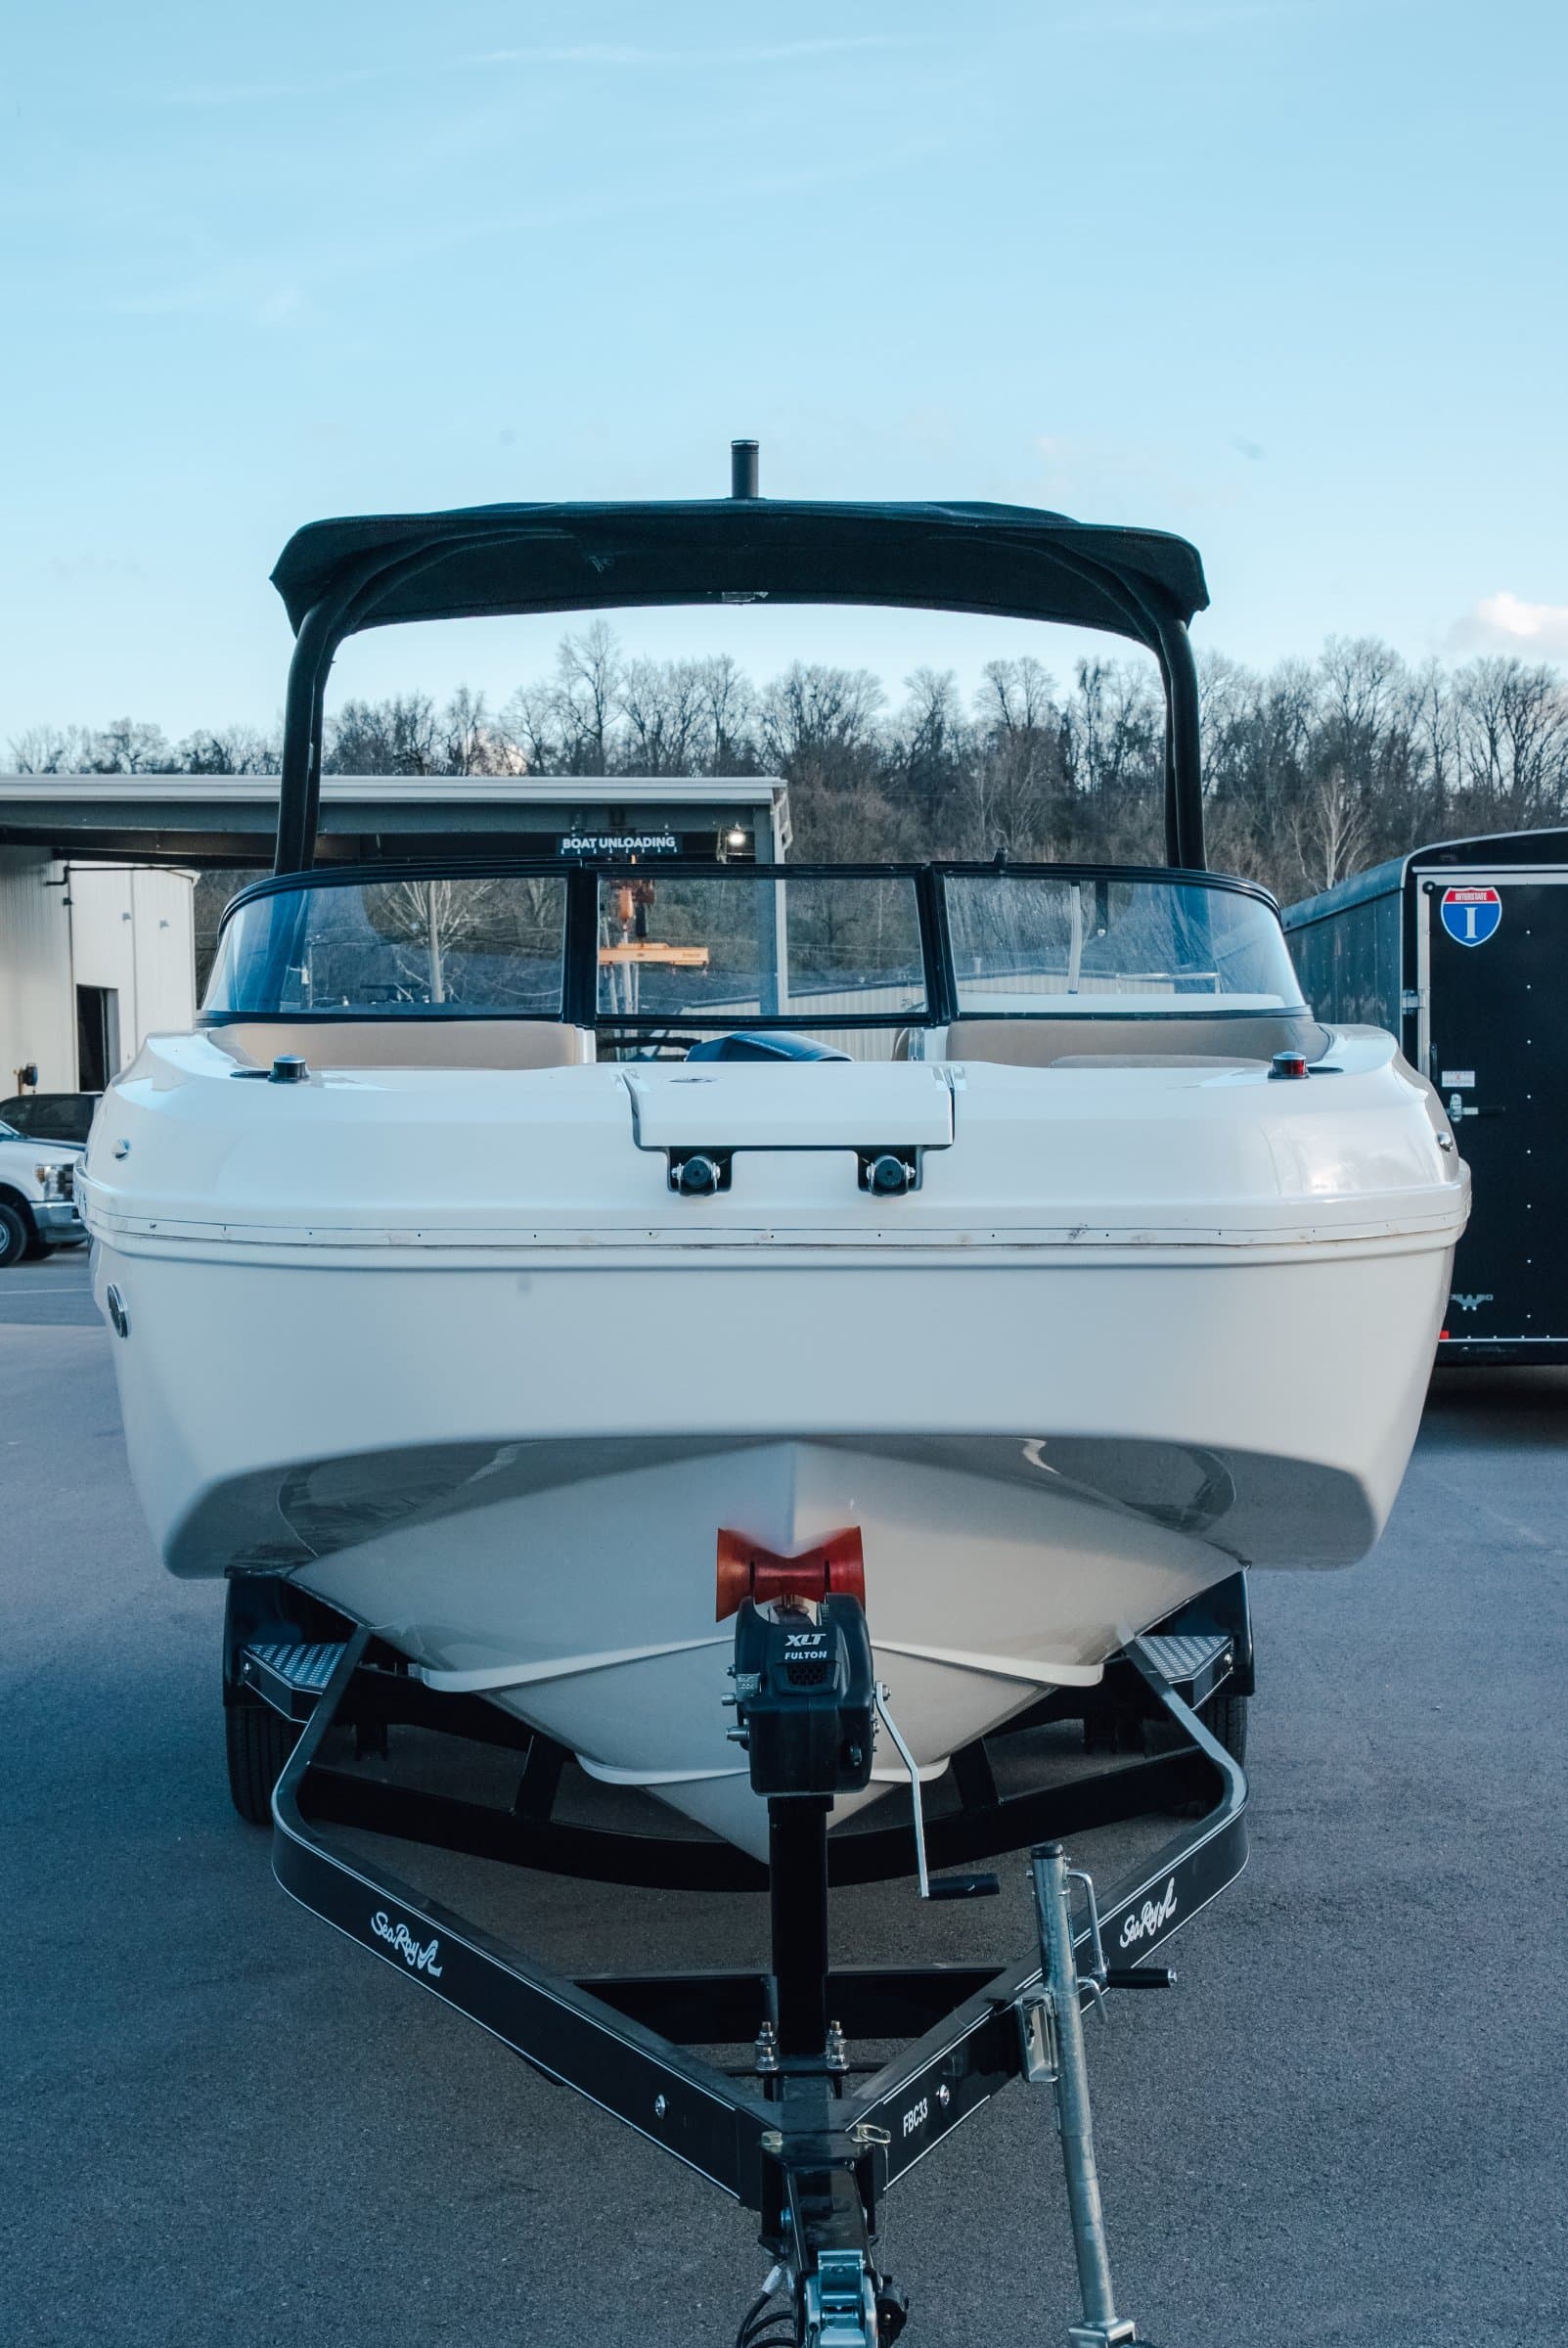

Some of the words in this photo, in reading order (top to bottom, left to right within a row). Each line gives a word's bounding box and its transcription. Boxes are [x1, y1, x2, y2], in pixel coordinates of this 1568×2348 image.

[562, 837, 597, 849] BOAT
[599, 836, 676, 849] UNLOADING
[1463, 907, 1479, 939] I
[784, 1633, 828, 1648] XLT
[784, 1650, 828, 1660] FULTON
[903, 2098, 928, 2138] FBC33
